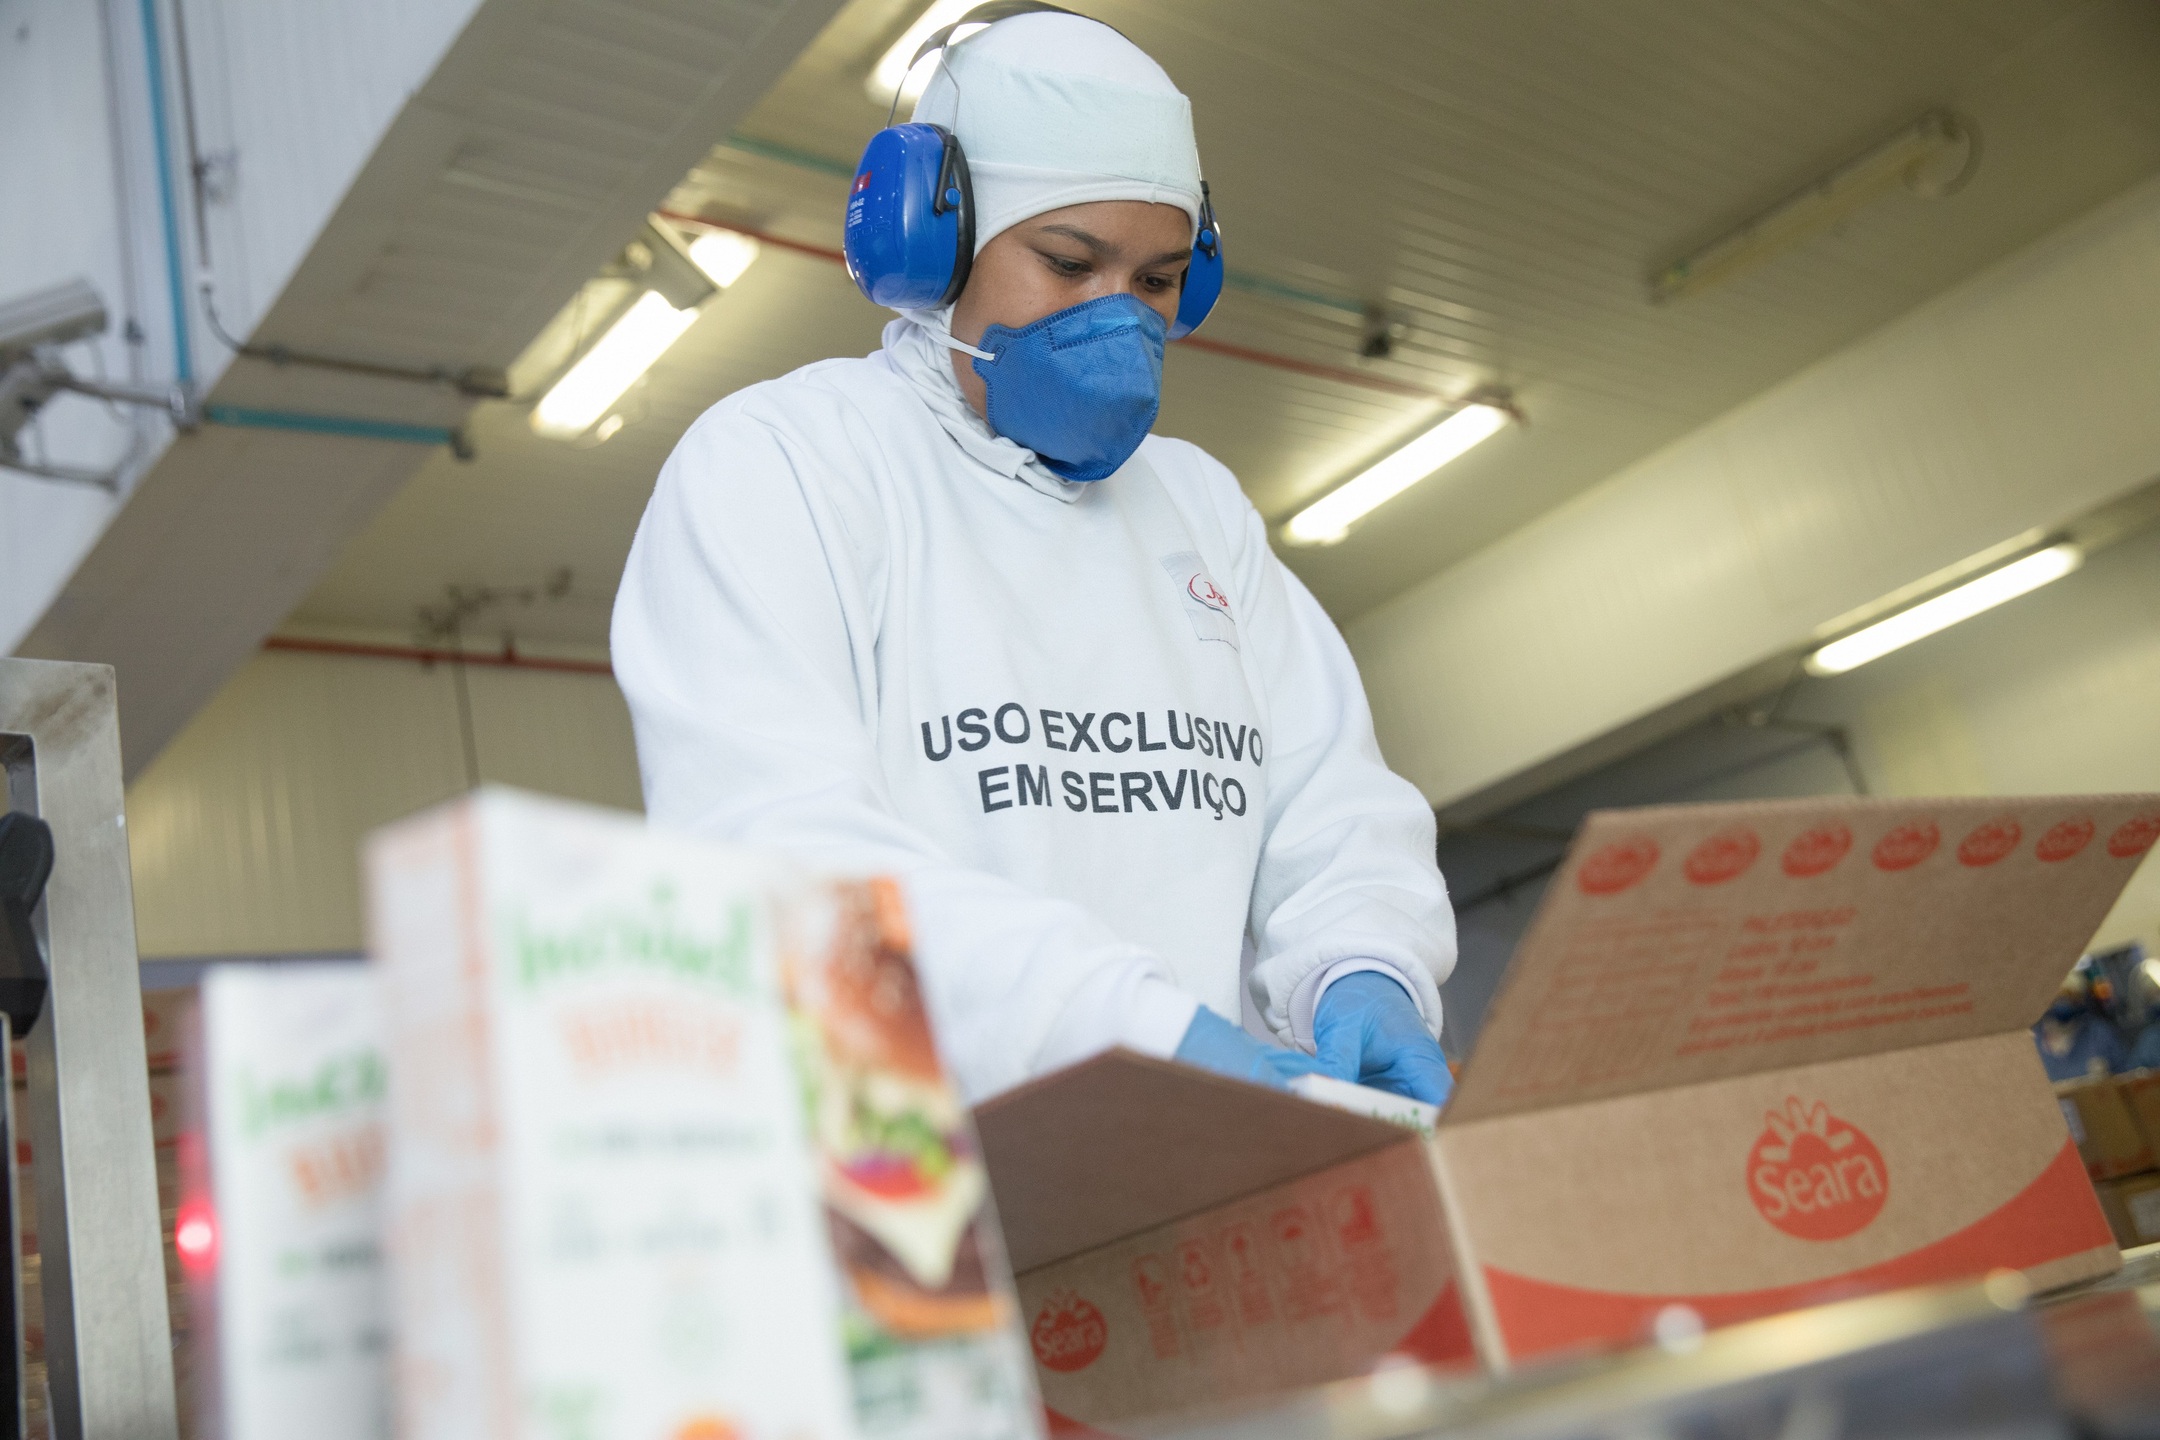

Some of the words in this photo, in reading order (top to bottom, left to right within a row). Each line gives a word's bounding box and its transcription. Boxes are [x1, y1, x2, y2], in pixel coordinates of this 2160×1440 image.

[921, 702, 1030, 762] USO
[1039, 709, 1263, 767] EXCLUSIVO
[978, 763, 1052, 813] EM
[1061, 768, 1247, 821] SERVIÇO
[1755, 1154, 1882, 1219] Seara
